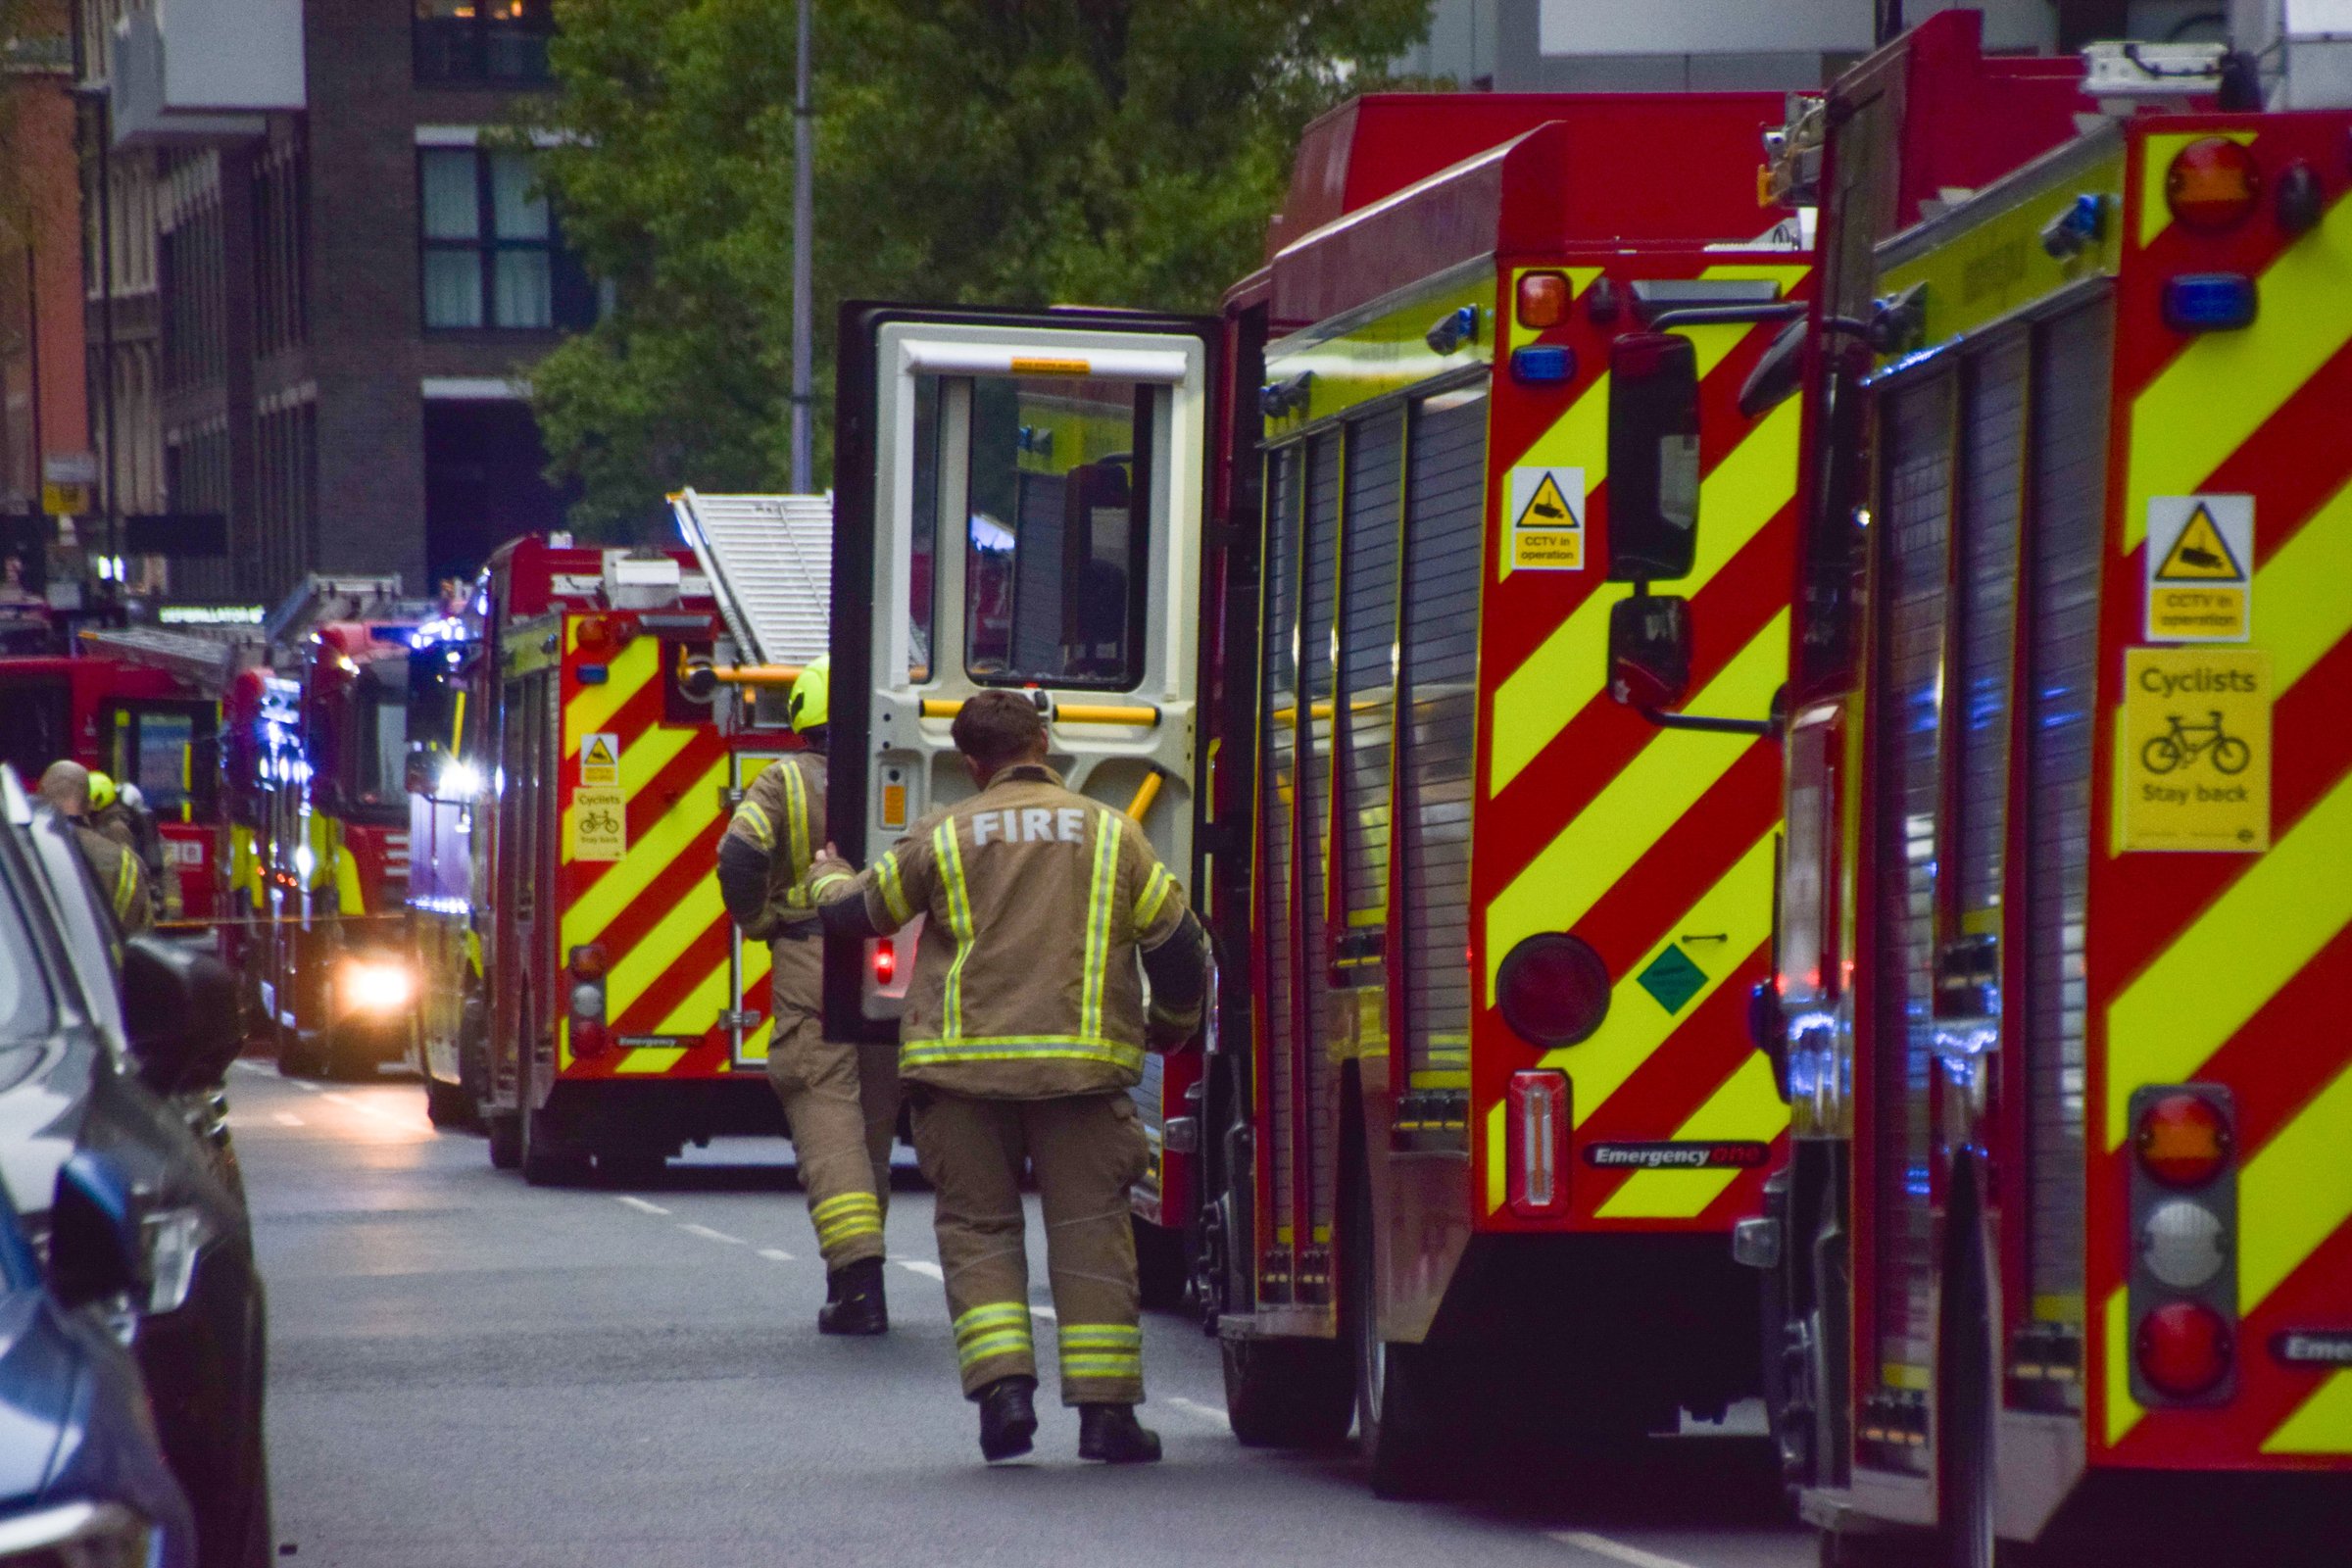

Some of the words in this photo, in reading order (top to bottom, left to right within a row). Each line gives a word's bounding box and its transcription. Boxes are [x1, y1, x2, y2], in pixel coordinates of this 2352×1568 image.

[1524, 536, 1557, 546] CCTV
[1560, 536, 1570, 546] in
[1521, 551, 1574, 561] operation
[2139, 666, 2258, 699] Cyclists
[578, 794, 620, 807] Cyclists
[2142, 783, 2189, 806] Stay
[2196, 783, 2249, 803] back
[972, 807, 1085, 847] FIRE
[1594, 1147, 1710, 1167] Emergency
